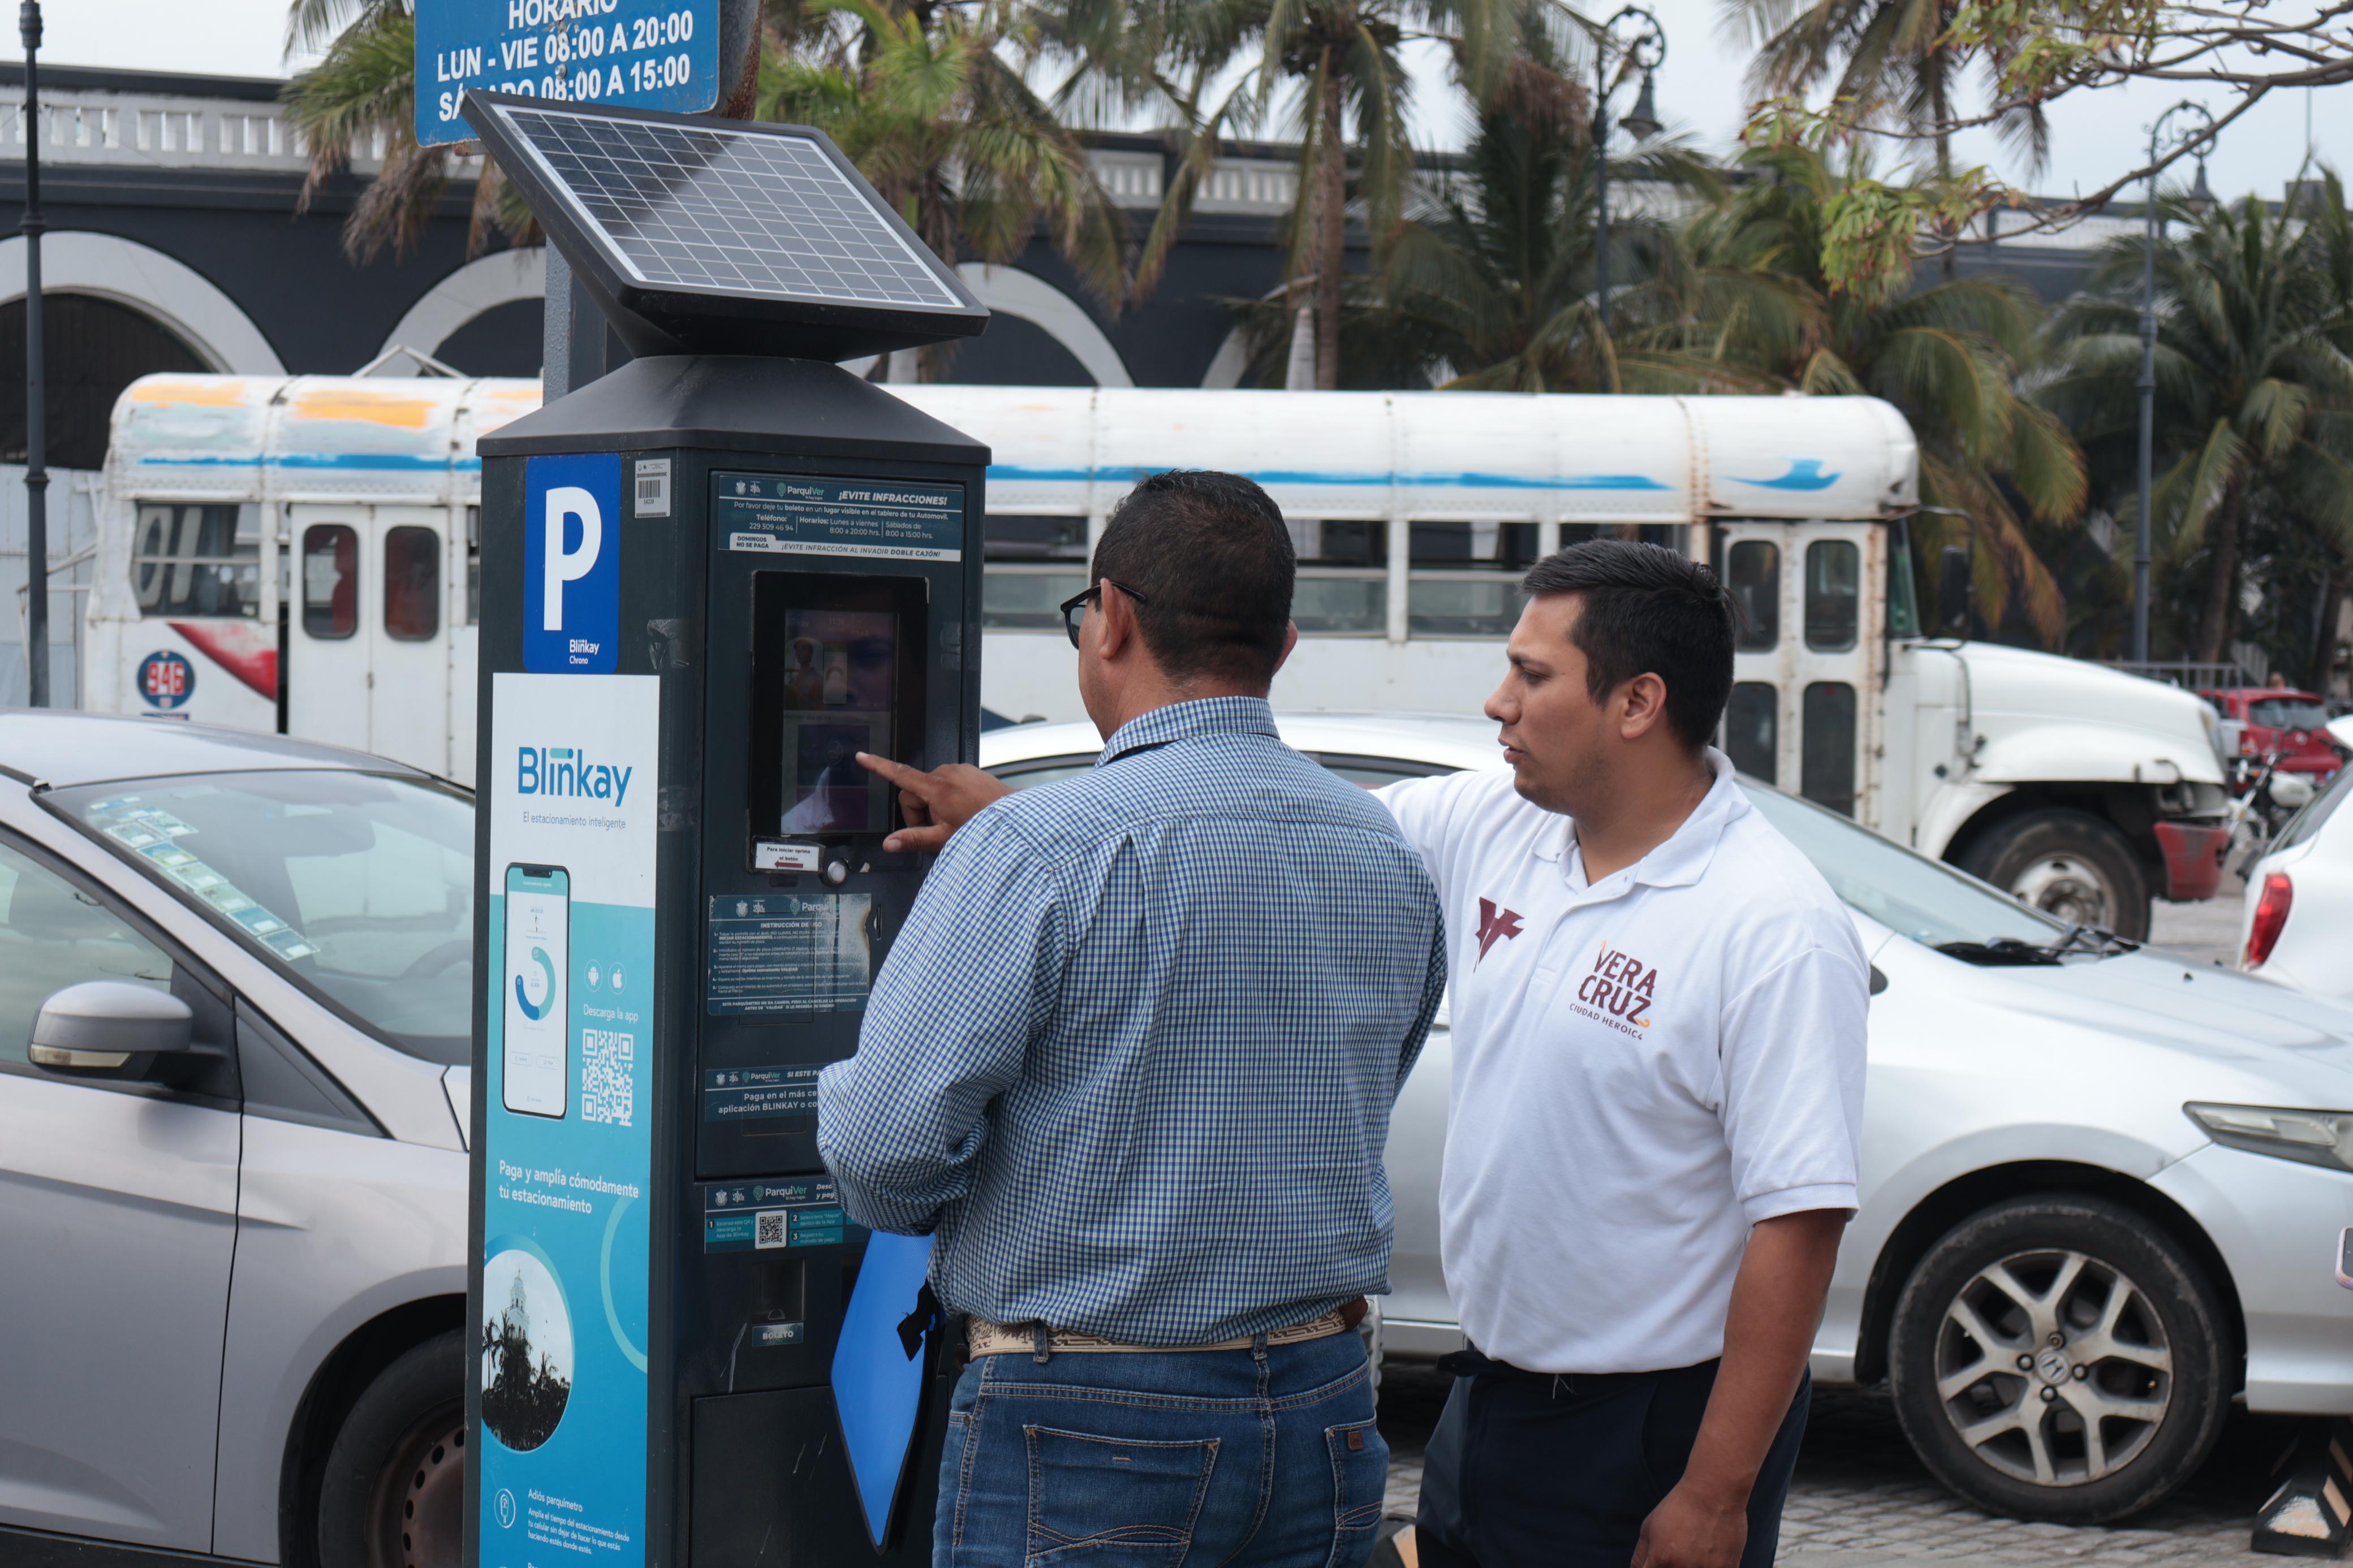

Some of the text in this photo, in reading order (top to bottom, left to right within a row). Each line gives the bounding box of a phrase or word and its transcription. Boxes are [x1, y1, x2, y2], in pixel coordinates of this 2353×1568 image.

[437, 10, 693, 82] LUN - VIE 08:00 A 20:00
[541, 68, 601, 101] 08:00
[606, 66, 624, 96] A
[630, 54, 690, 93] 15:00
[787, 486, 824, 496] ParquiVer
[838, 491, 947, 505] ¡EVITE INFRACCIONES!
[544, 486, 602, 630] P
[569, 640, 600, 655] Blinkay
[569, 656, 588, 664] Chrono
[147, 662, 185, 695] 946
[518, 746, 632, 807] Blinkay
[523, 811, 626, 830] El estacionamiento inteligente
[1594, 941, 1657, 998] VERA
[1570, 1003, 1600, 1020] CIUDAD
[1579, 975, 1651, 1027] CRUZ
[584, 1004, 638, 1023] Descarga la app
[751, 1072, 781, 1081] ParquiVer
[718, 1104, 760, 1115] aplicación
[762, 1102, 798, 1111] BLINKAY
[499, 1160, 639, 1198] Paga y amplía cómodamente
[512, 1189, 592, 1213] estacionamiento
[765, 1185, 807, 1198] ParquiVer
[762, 1331, 794, 1340] BOLETO
[528, 1489, 583, 1512] Adiós parquímetro
[528, 1507, 544, 1520] Amplía
[550, 1514, 566, 1526] tiempo
[575, 1522, 614, 1538] estacionamiento
[614, 1531, 630, 1542] desde
[534, 1522, 549, 1531] celular
[558, 1527, 570, 1538] dejar
[571, 1531, 577, 1539] de
[578, 1532, 591, 1543] hacer
[592, 1536, 597, 1545] lo
[528, 1530, 592, 1554] haciendo estés donde estés.
